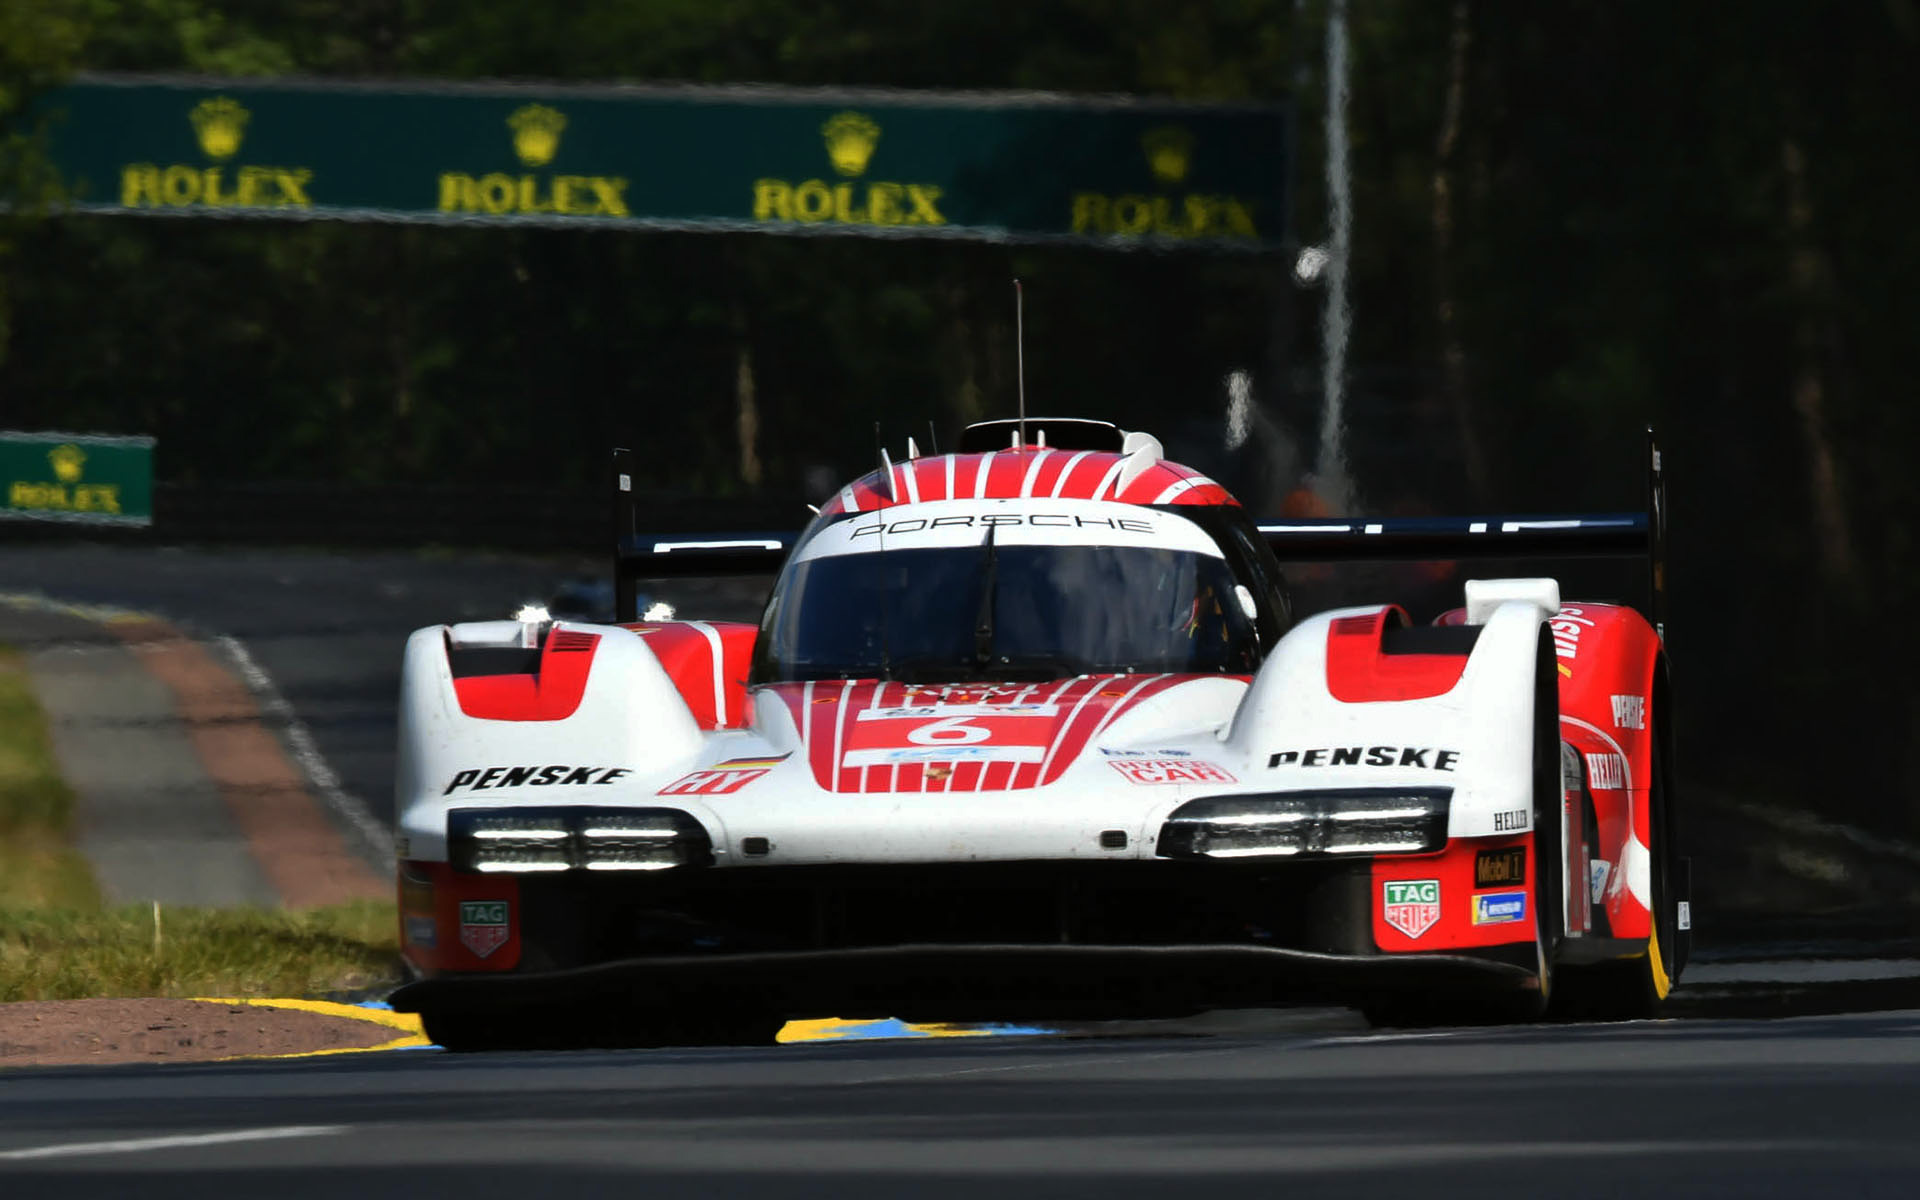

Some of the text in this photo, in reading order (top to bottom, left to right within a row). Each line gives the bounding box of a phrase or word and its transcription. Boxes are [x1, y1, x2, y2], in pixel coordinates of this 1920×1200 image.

[122, 164, 313, 208] ROLEX
[439, 172, 631, 217] ROLEX
[754, 178, 948, 226] ROLEX
[850, 514, 1155, 541] PORSCHE
[906, 716, 992, 745] 6
[1117, 760, 1210, 769] HYPER
[1267, 746, 1461, 772] PENSKE
[442, 765, 633, 797] PENSKE
[661, 771, 760, 793] HY
[1130, 768, 1226, 782] CAR
[1389, 884, 1435, 902] TAG
[463, 905, 504, 922] TAG
